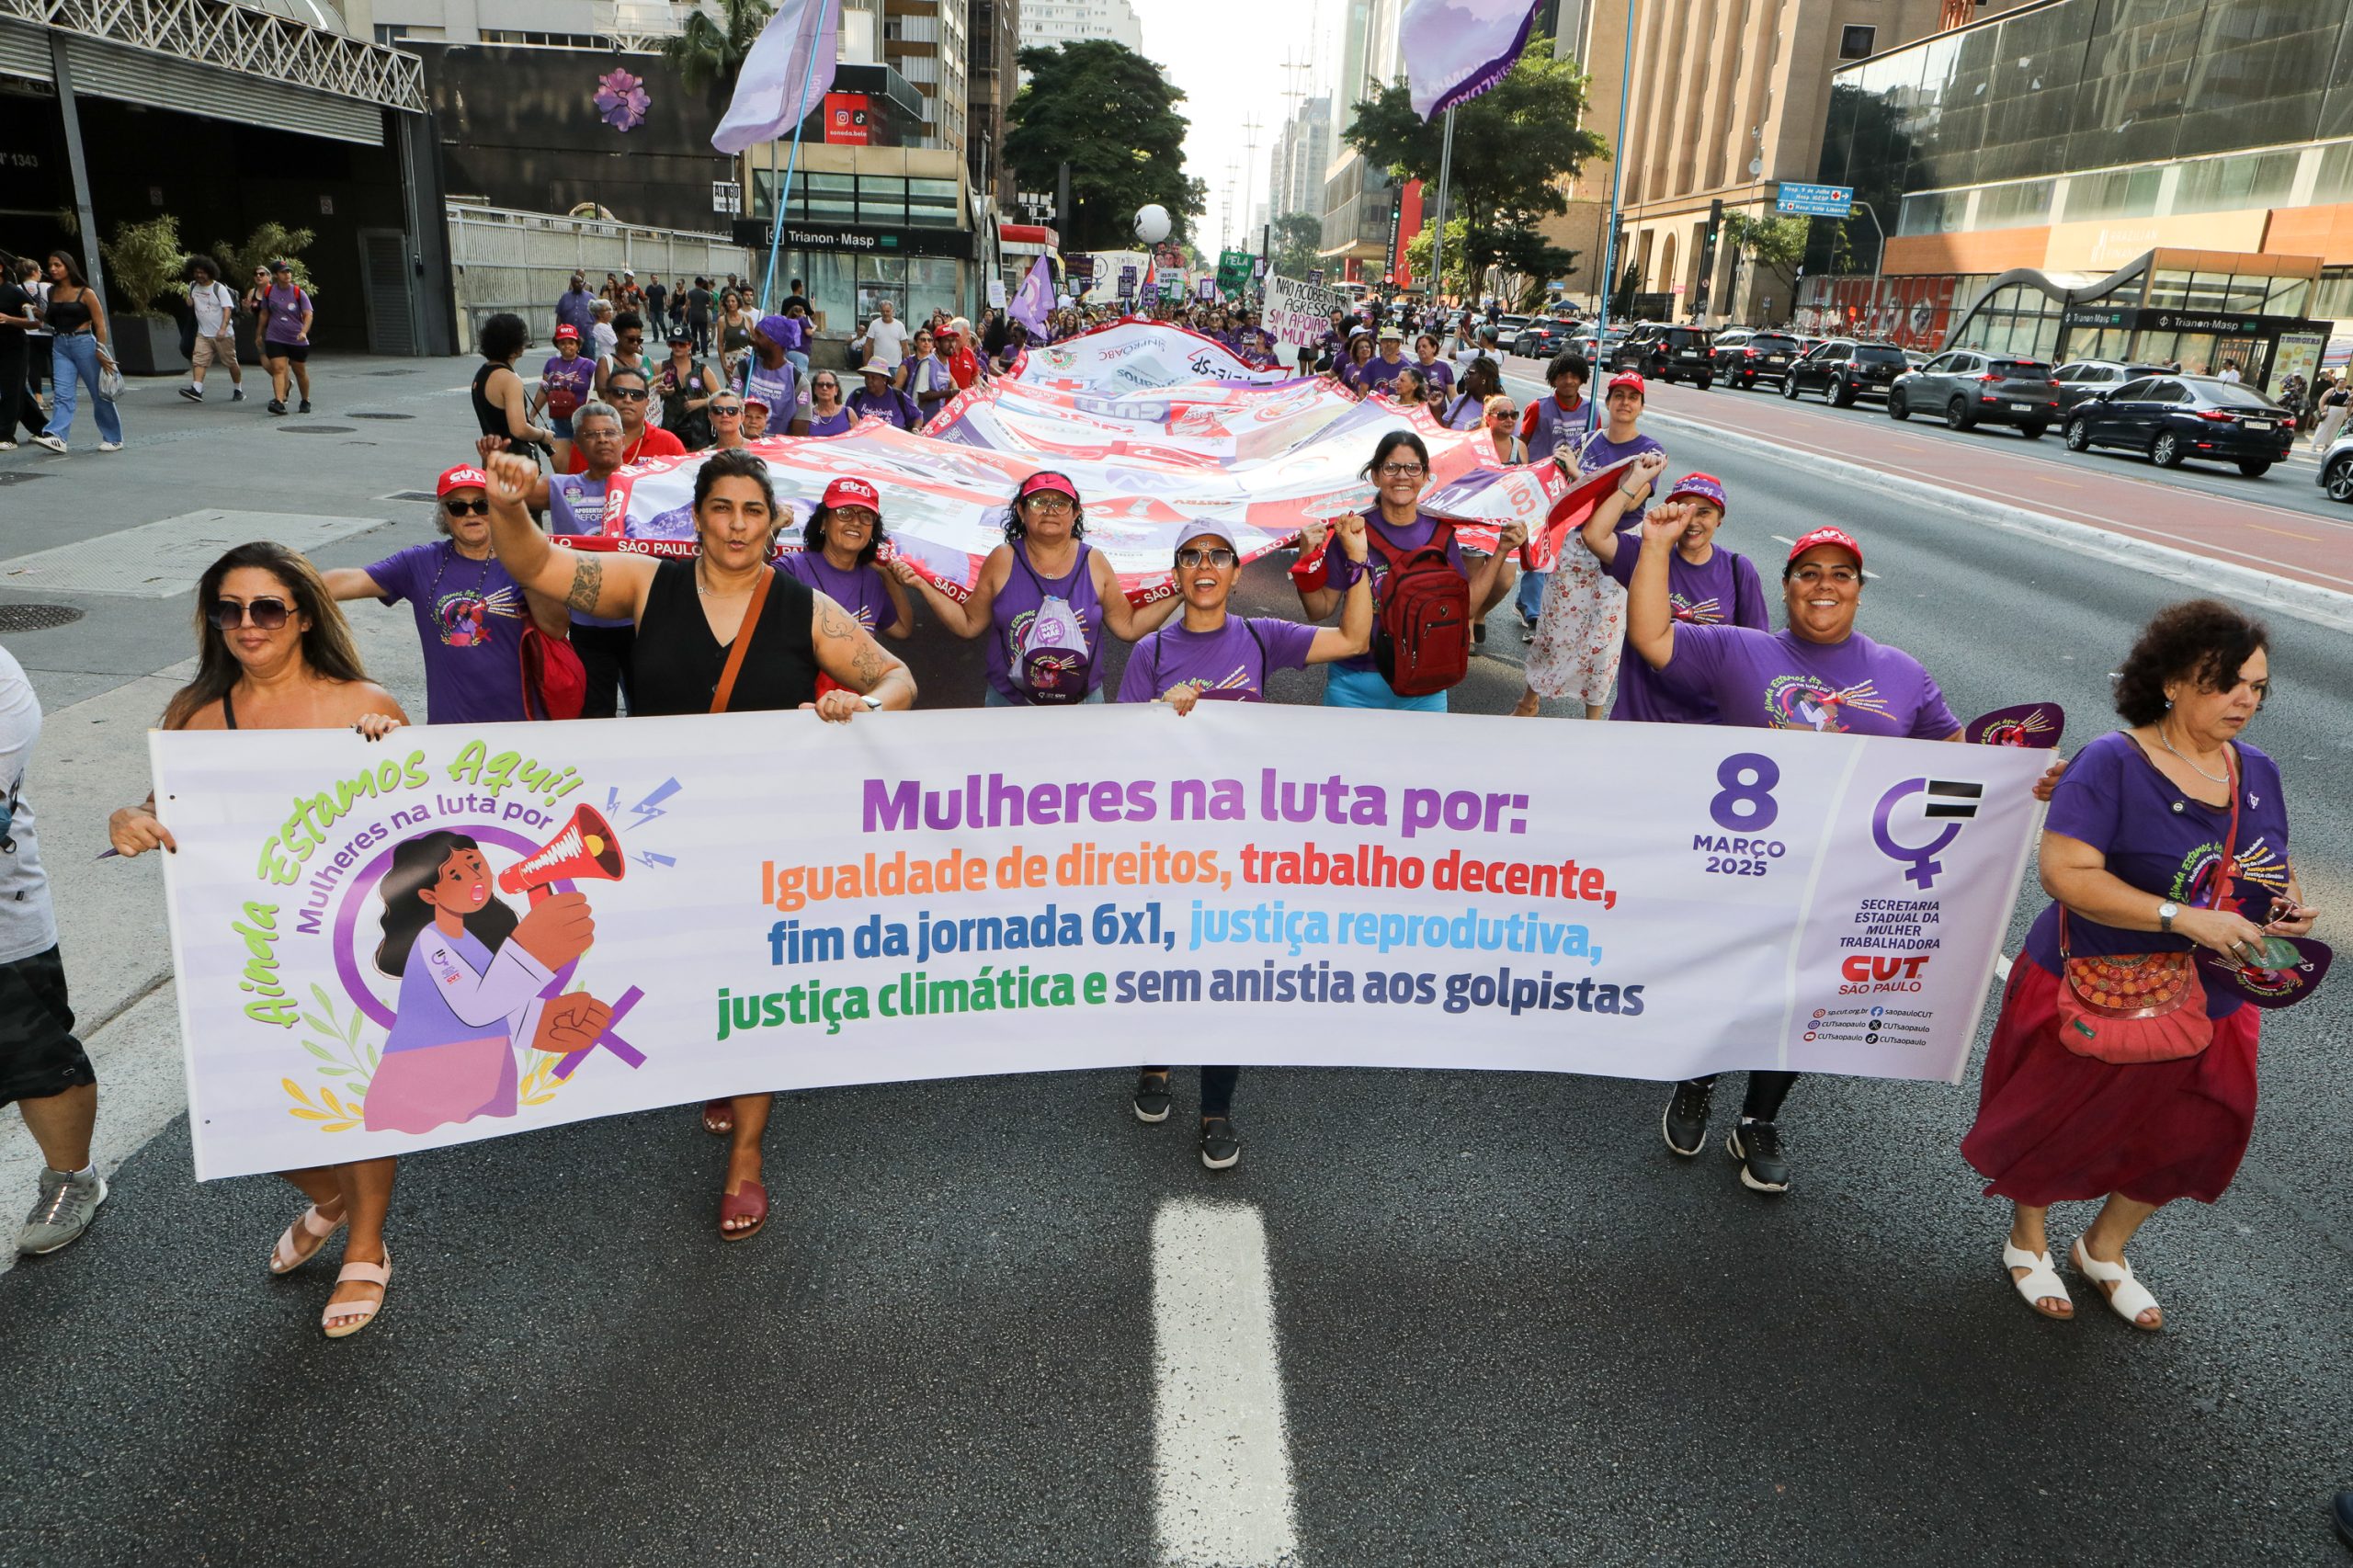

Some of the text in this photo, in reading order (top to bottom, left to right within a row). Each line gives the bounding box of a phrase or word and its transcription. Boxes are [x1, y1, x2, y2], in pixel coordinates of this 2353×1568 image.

[1289, 313, 1328, 333] APOIAR
[1281, 326, 1320, 347] MULH
[574, 513, 603, 521] REFOR
[618, 540, 650, 553] SÃO
[934, 575, 958, 597] SÃO
[1142, 583, 1171, 604] SÃO
[863, 768, 1529, 838] Mulheres na luta por:
[1710, 752, 1780, 833] 8
[257, 749, 430, 886] Estamos
[1692, 834, 1786, 860] MARÇO
[295, 791, 554, 936] Mulheres na luta por
[1705, 856, 1768, 877] 2025
[761, 840, 1618, 913] Igualdade de direitos, trabalho decente,
[1860, 899, 1940, 912] SECRETARIA
[1854, 912, 1940, 924] ESTADUAL DA
[767, 899, 1603, 967] fim da jornada 6x1, justiça reprodutiva,
[1866, 925, 1922, 937] MULHER
[1839, 937, 1940, 950] TRABALHADORA
[233, 901, 300, 1028] Ainda
[1841, 955, 1930, 983] CUT
[1838, 981, 1922, 995] SÃO PAULO
[717, 959, 1645, 1041] justiça climática e sem anistia aos golpistas
[1821, 1020, 1867, 1028] CUTsaopaulo
[1884, 1008, 1934, 1019] saopauloCUT
[1817, 1032, 1863, 1042] CUTsaopaulo
[1882, 1022, 1931, 1033] CUTsaopaulo
[1879, 1036, 1927, 1046] CUTsaopaulo
